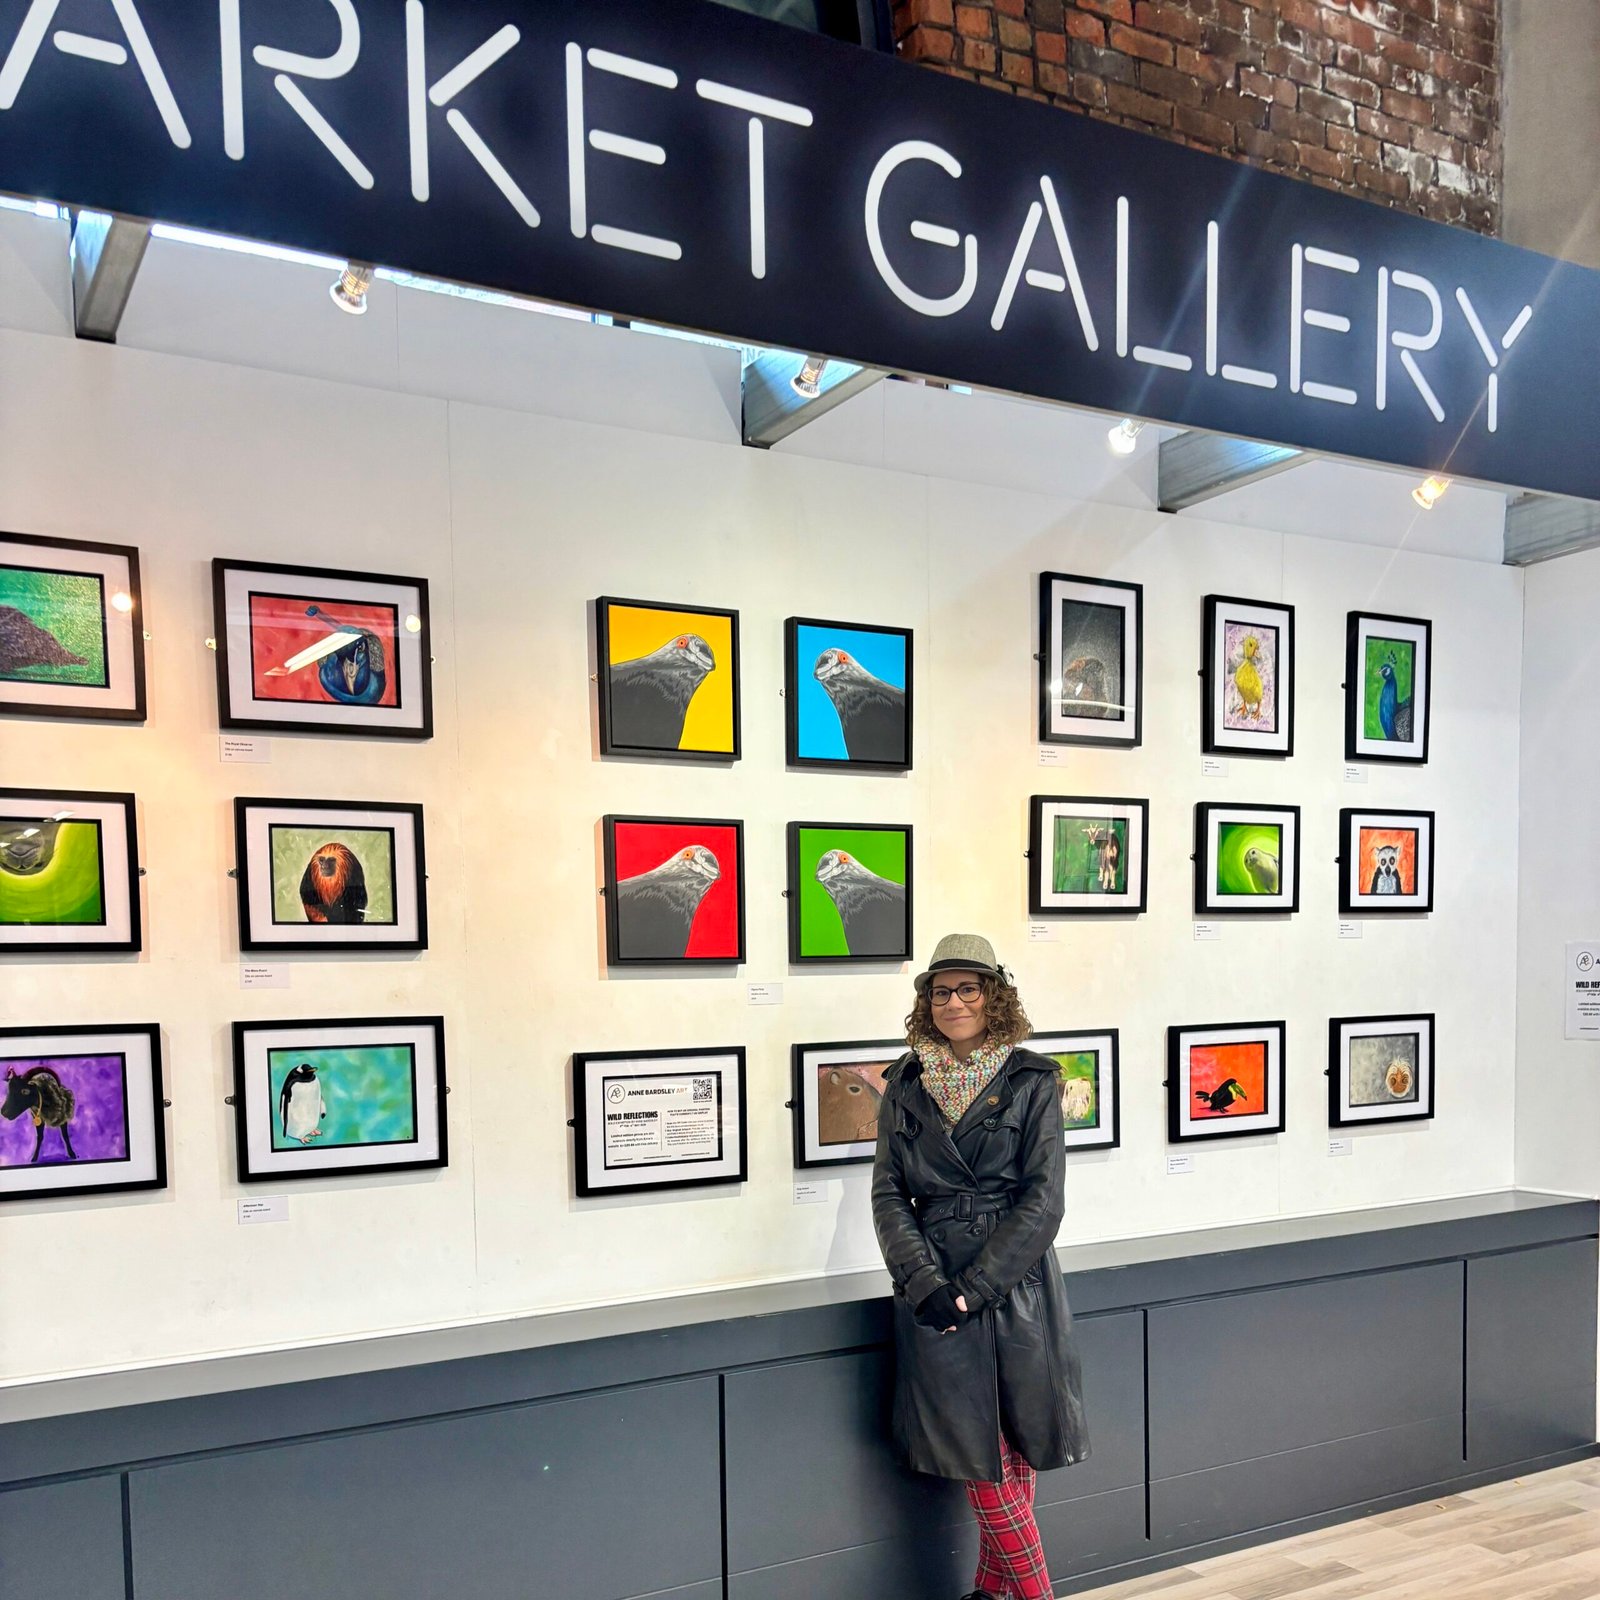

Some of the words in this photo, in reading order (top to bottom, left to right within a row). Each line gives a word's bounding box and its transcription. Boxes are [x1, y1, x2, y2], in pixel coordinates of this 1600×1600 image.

[0, 0, 814, 279] ARKET
[864, 140, 1533, 433] GALLERY
[1576, 981, 1590, 989] WILD
[645, 1088, 675, 1096] BARDSLEY
[607, 1113, 622, 1121] WILD
[623, 1110, 659, 1120] REFLECTIONS
